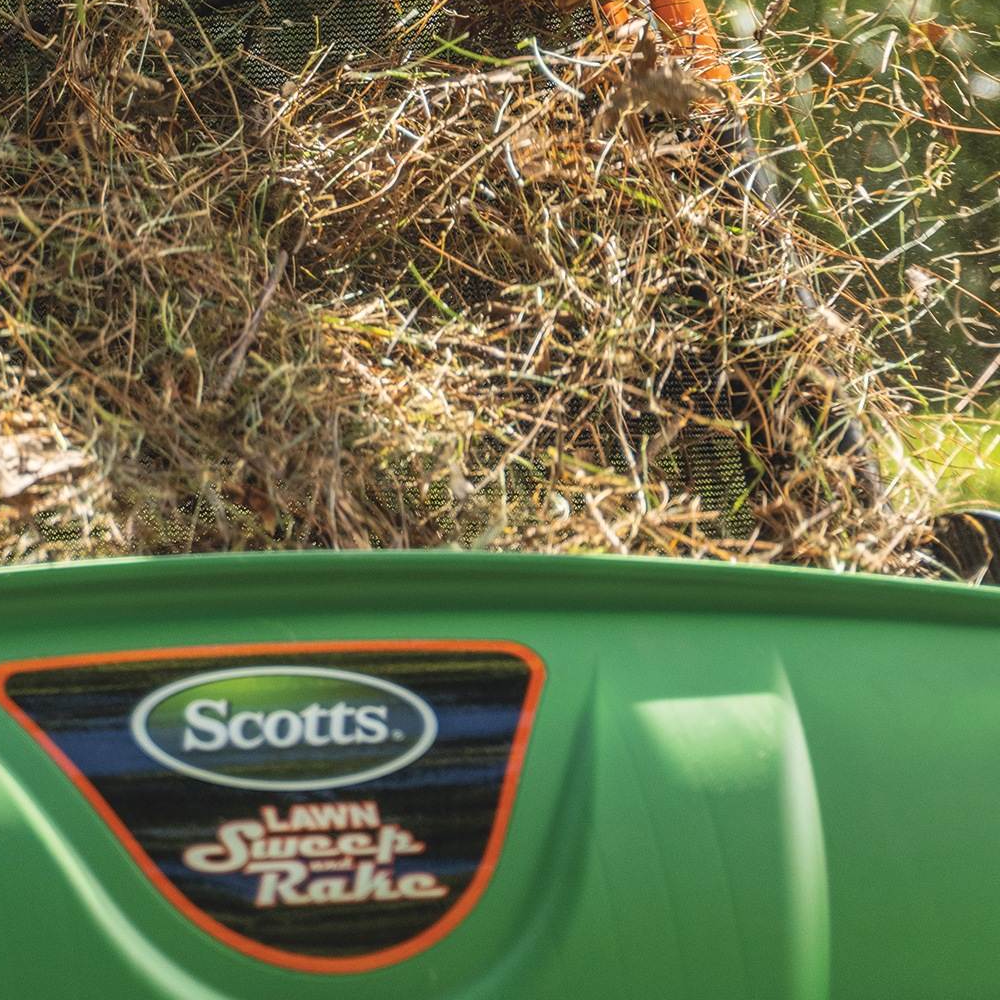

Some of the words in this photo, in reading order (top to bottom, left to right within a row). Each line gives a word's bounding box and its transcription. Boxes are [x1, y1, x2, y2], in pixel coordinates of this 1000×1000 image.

[184, 699, 389, 751] Scotts
[261, 800, 380, 832] LAWN
[183, 819, 426, 873] Sweep
[244, 859, 449, 908] Rake
